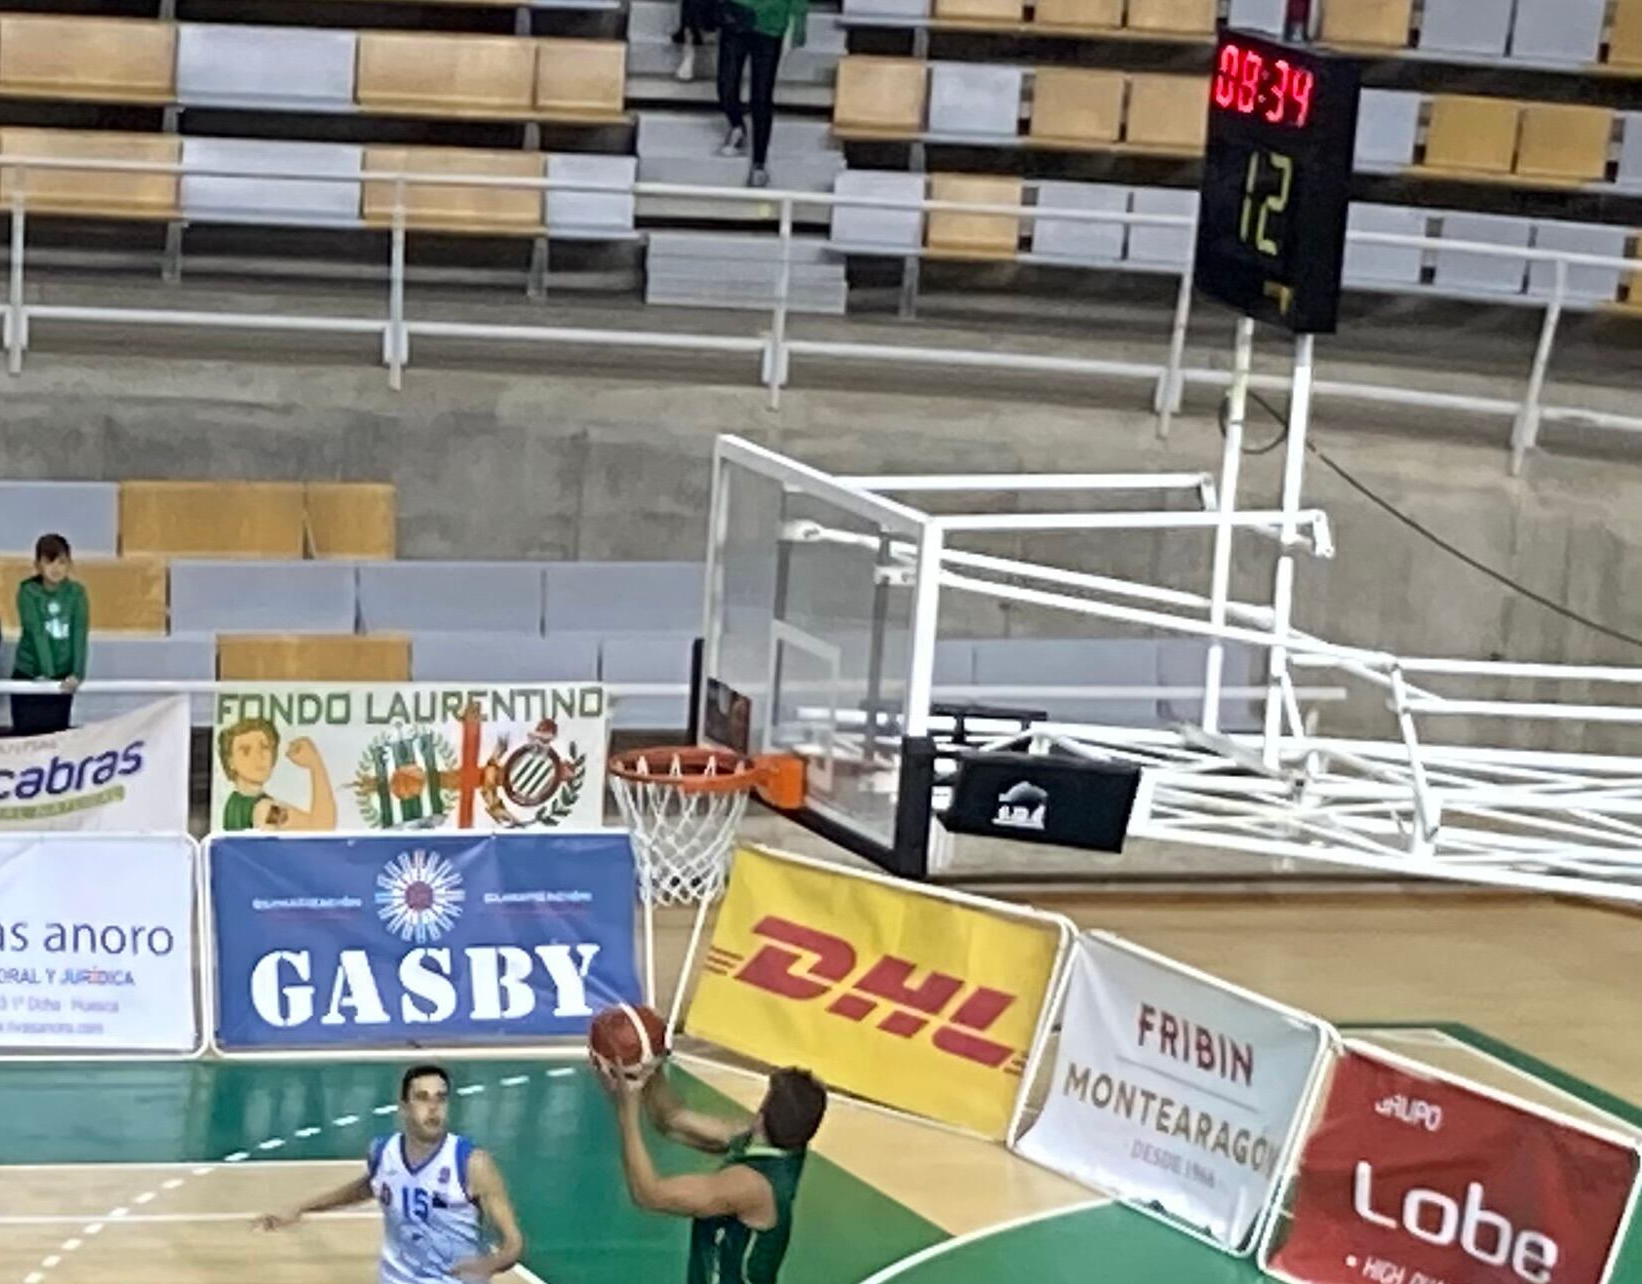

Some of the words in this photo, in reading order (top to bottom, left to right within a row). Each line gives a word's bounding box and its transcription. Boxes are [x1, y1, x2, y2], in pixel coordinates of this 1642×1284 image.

[1240, 151, 1294, 257] 12
[217, 691, 351, 726] FONDO
[365, 686, 604, 726] LAURENTINO
[43, 921, 175, 956] anoro
[250, 943, 601, 1028] GASBY
[734, 915, 1018, 1059] DHL
[1137, 1003, 1255, 1088] FRIBIN
